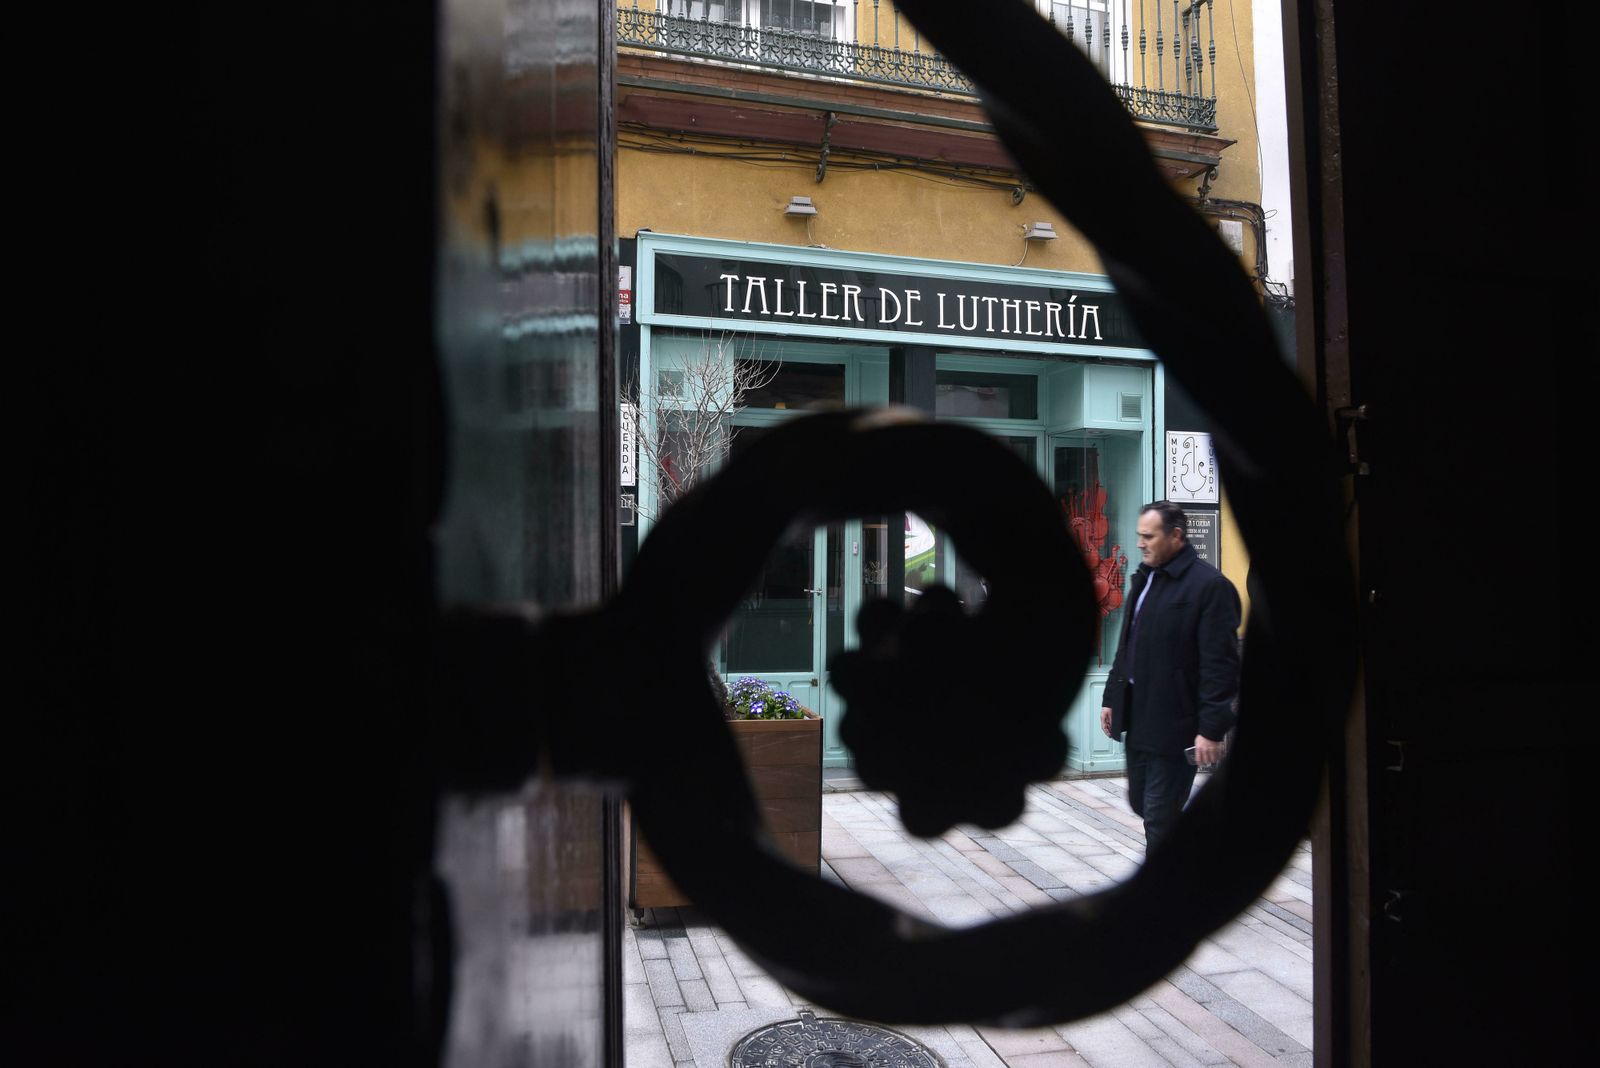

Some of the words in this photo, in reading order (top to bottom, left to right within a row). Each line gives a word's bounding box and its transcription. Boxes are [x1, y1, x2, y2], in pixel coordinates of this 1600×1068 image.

[719, 273, 865, 322] TALLER
[879, 287, 924, 326] DE
[937, 293, 1103, 340] LUTHERÍA
